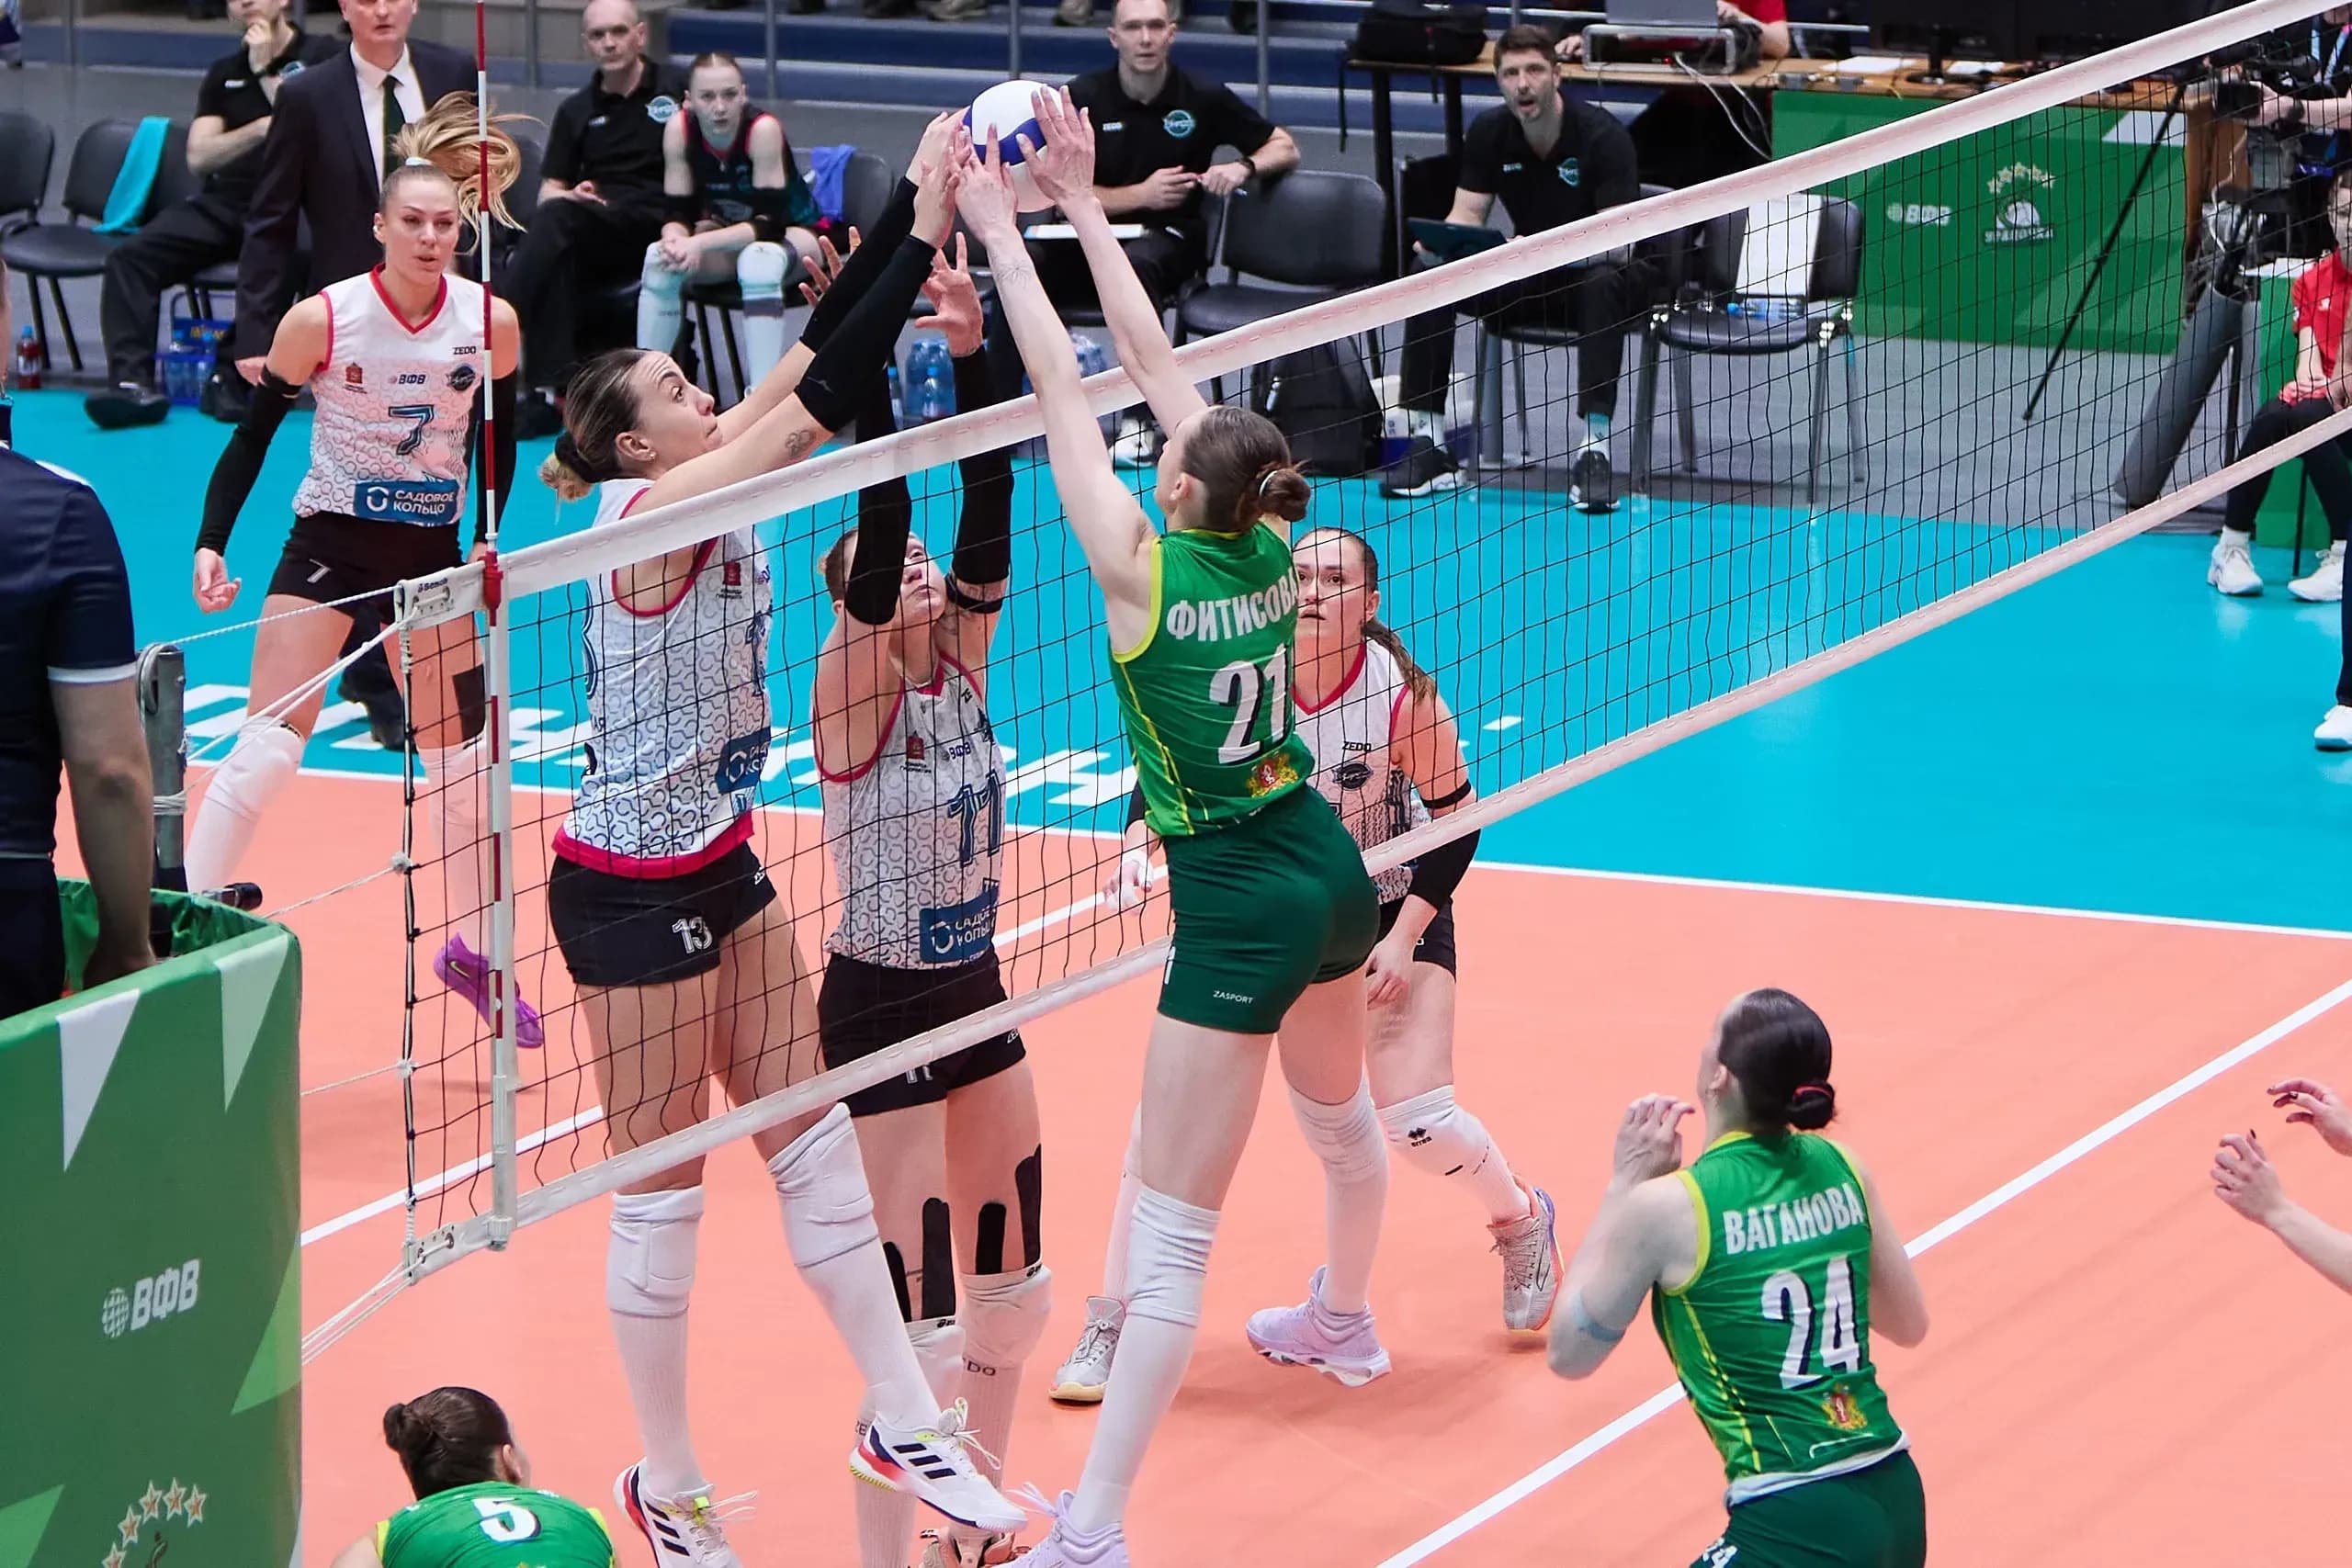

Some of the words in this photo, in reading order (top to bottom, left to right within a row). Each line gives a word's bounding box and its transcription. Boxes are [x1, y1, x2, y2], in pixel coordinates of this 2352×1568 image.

[453, 345, 477, 355] ZEDO
[399, 374, 426, 385] ВФВ
[388, 404, 435, 456] 7
[393, 501, 446, 515] КОЛЬЦО
[394, 490, 455, 502] САДОВОЕ
[307, 558, 332, 583] 7
[1209, 642, 1287, 765] 21
[1342, 740, 1372, 752] ZEDO
[947, 769, 1001, 868] 11
[672, 917, 713, 954] 13
[1213, 990, 1254, 1005] ZASPORT
[1723, 1182, 1864, 1255] ВАГАНОВА
[130, 1258, 199, 1331] ВФВ
[1761, 1254, 1860, 1390] 24
[963, 1358, 997, 1376] DO
[472, 1497, 541, 1544] 5
